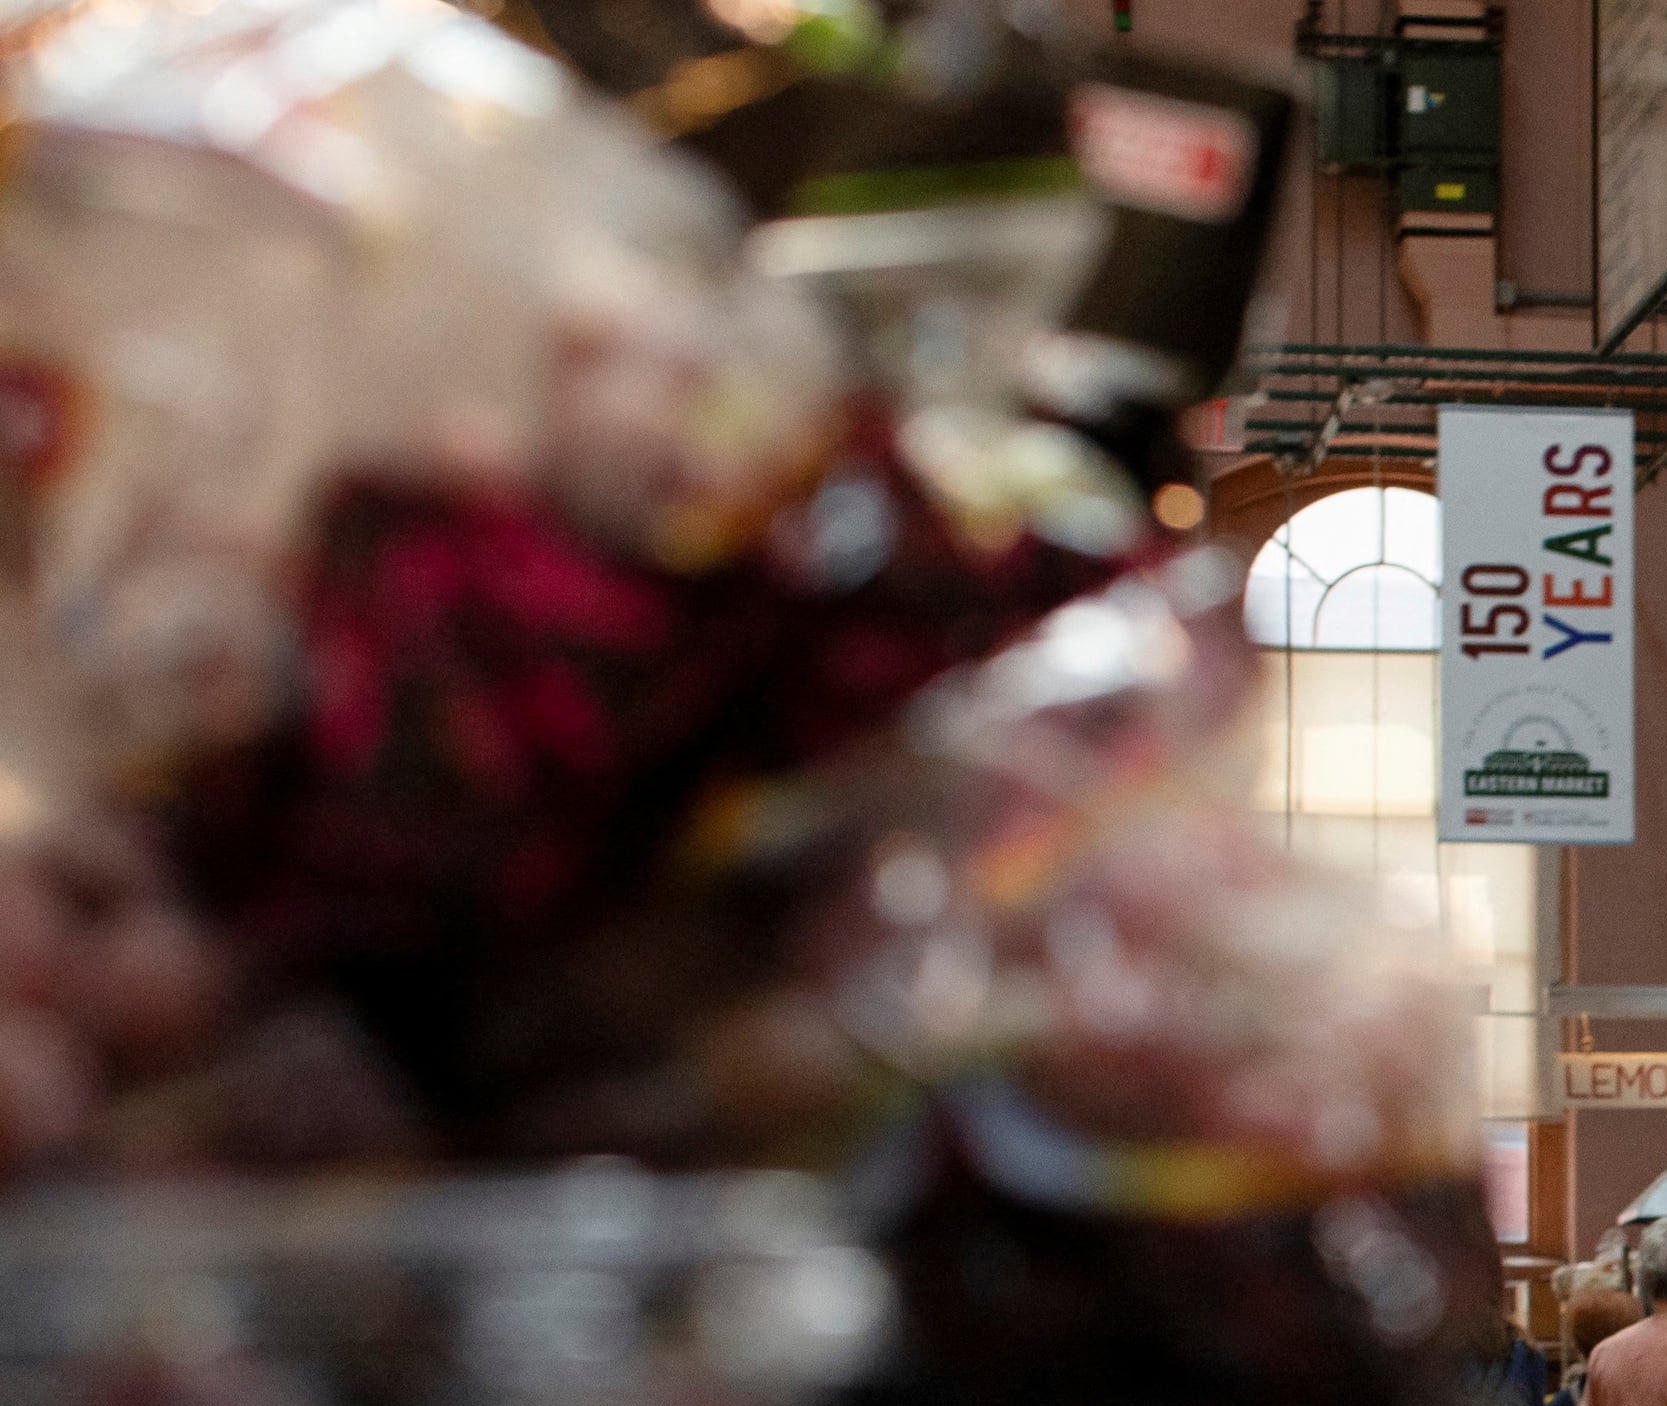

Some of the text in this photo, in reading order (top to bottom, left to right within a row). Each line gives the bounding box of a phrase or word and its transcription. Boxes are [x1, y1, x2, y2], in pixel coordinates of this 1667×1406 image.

[1542, 444, 1613, 659] YEARS
[1461, 564, 1531, 659] 150
[1467, 775, 1606, 792] EASTERN MARKET
